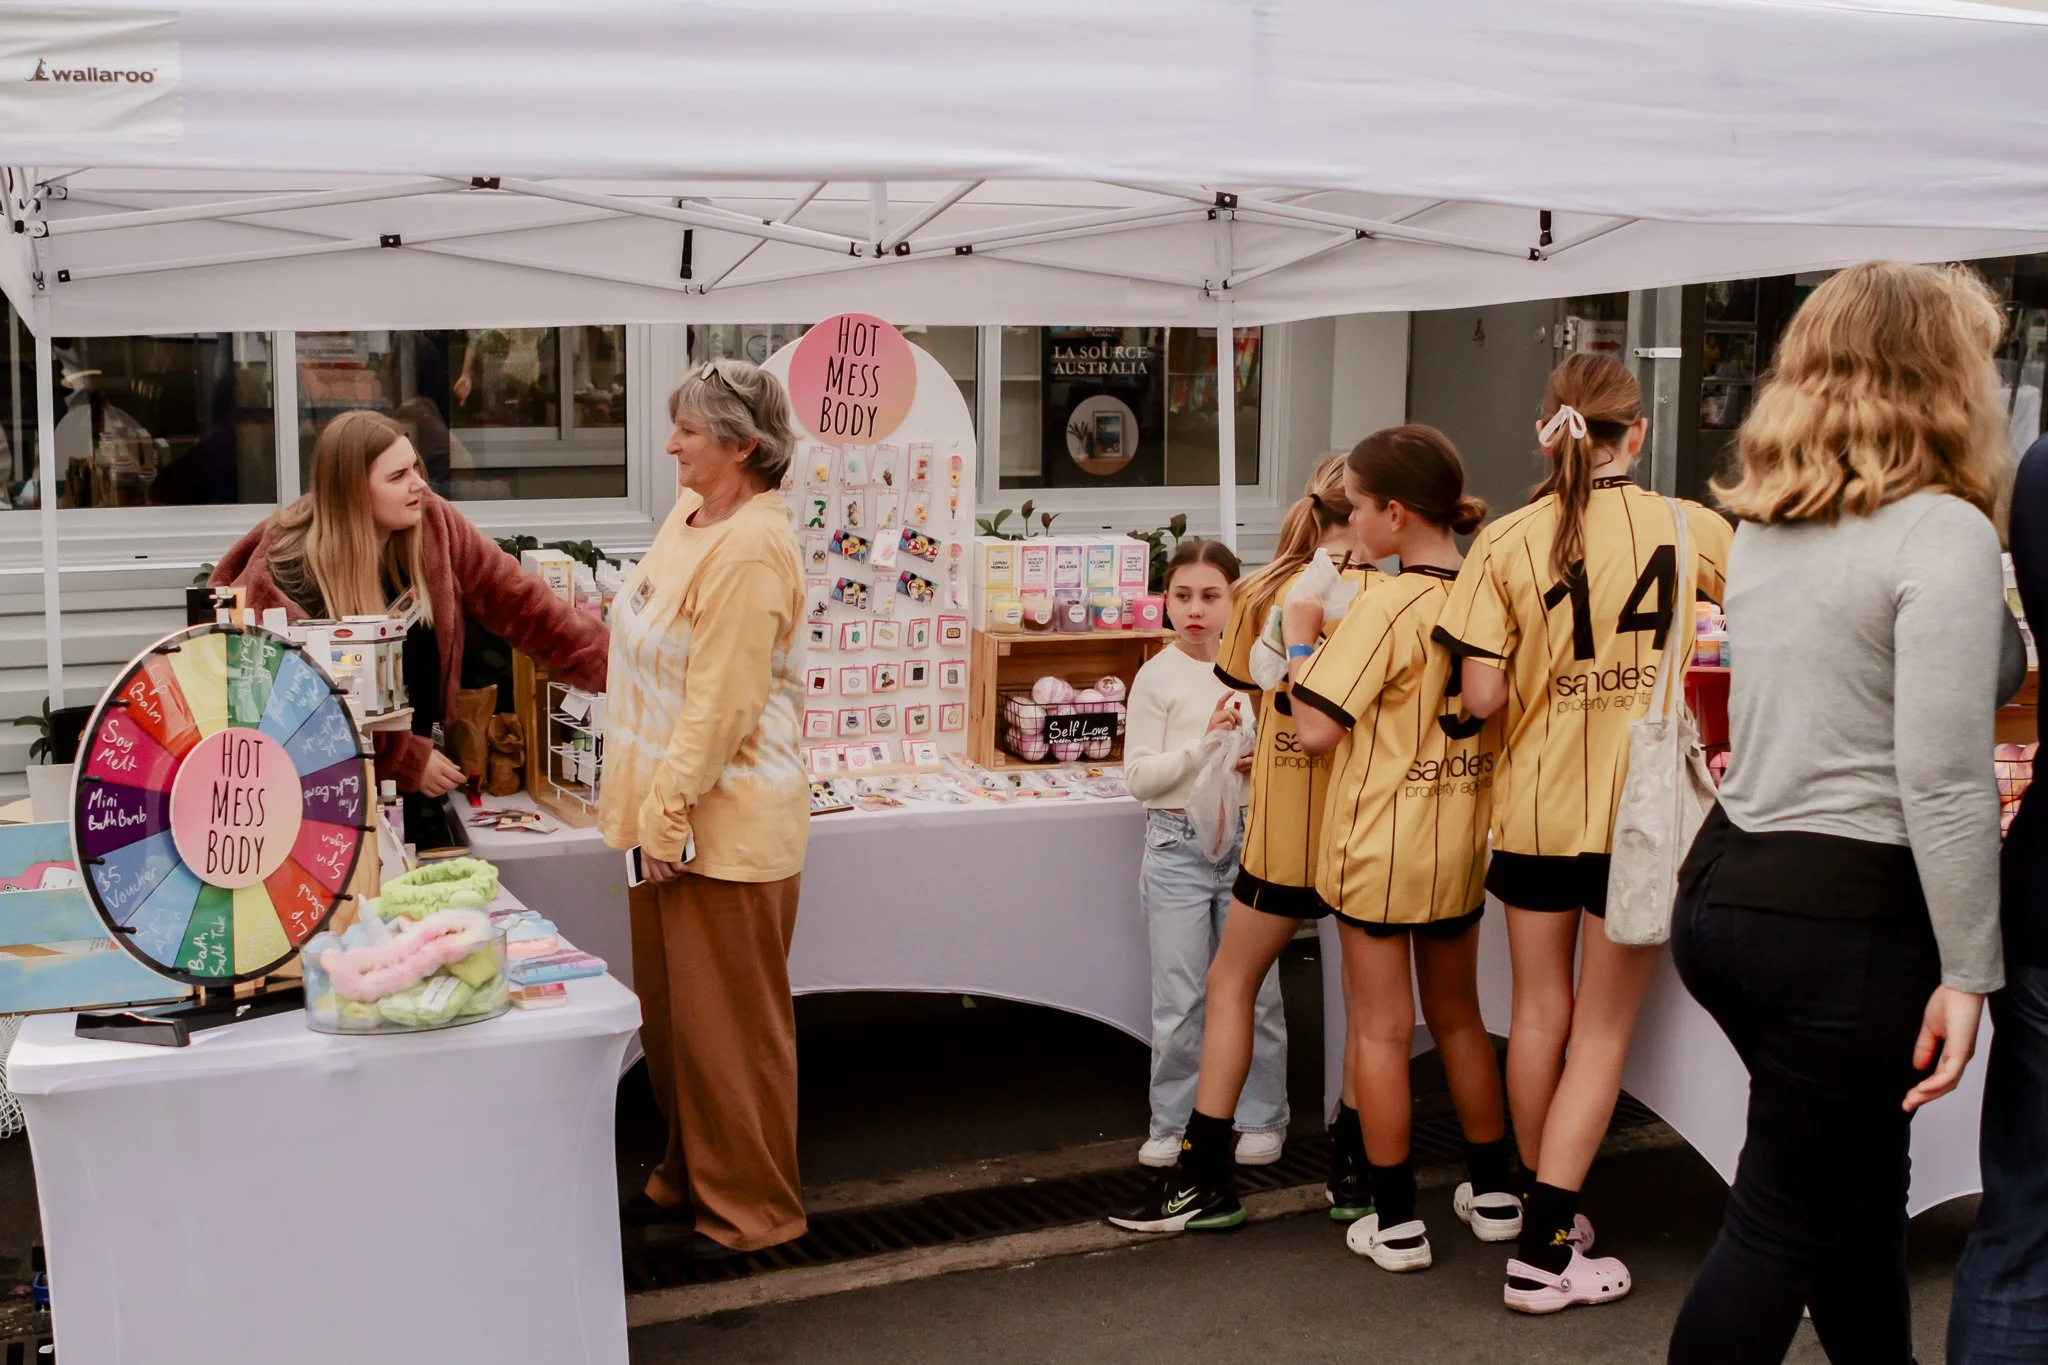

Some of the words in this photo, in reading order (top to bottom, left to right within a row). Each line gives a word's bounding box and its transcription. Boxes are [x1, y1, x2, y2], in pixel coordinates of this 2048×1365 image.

[51, 66, 155, 84] wallaroo
[837, 316, 881, 358] HOT
[1053, 346, 1075, 359] LA
[1080, 346, 1148, 359] SOURCE
[825, 355, 881, 399] MESS
[1053, 361, 1149, 375] AUSTRALIA
[819, 396, 879, 438] BODY
[1543, 544, 1677, 662] 14
[129, 681, 163, 725] Balm
[102, 719, 134, 753] Soy
[1049, 720, 1080, 740] Self
[1082, 719, 1109, 737] Love
[96, 747, 138, 772] Melt
[222, 733, 264, 778] HOT
[1274, 755, 1331, 772] property
[1405, 748, 1495, 782] sanders
[87, 787, 118, 810] Mini
[211, 780, 266, 828] MESS
[206, 829, 266, 875] BODY
[321, 832, 353, 855] Again
[97, 864, 122, 894] $5
[315, 851, 346, 880] Spin
[106, 865, 158, 909] Voucher
[298, 883, 325, 922] Scrub
[290, 909, 308, 938] Lip
[187, 931, 209, 972] Bath
